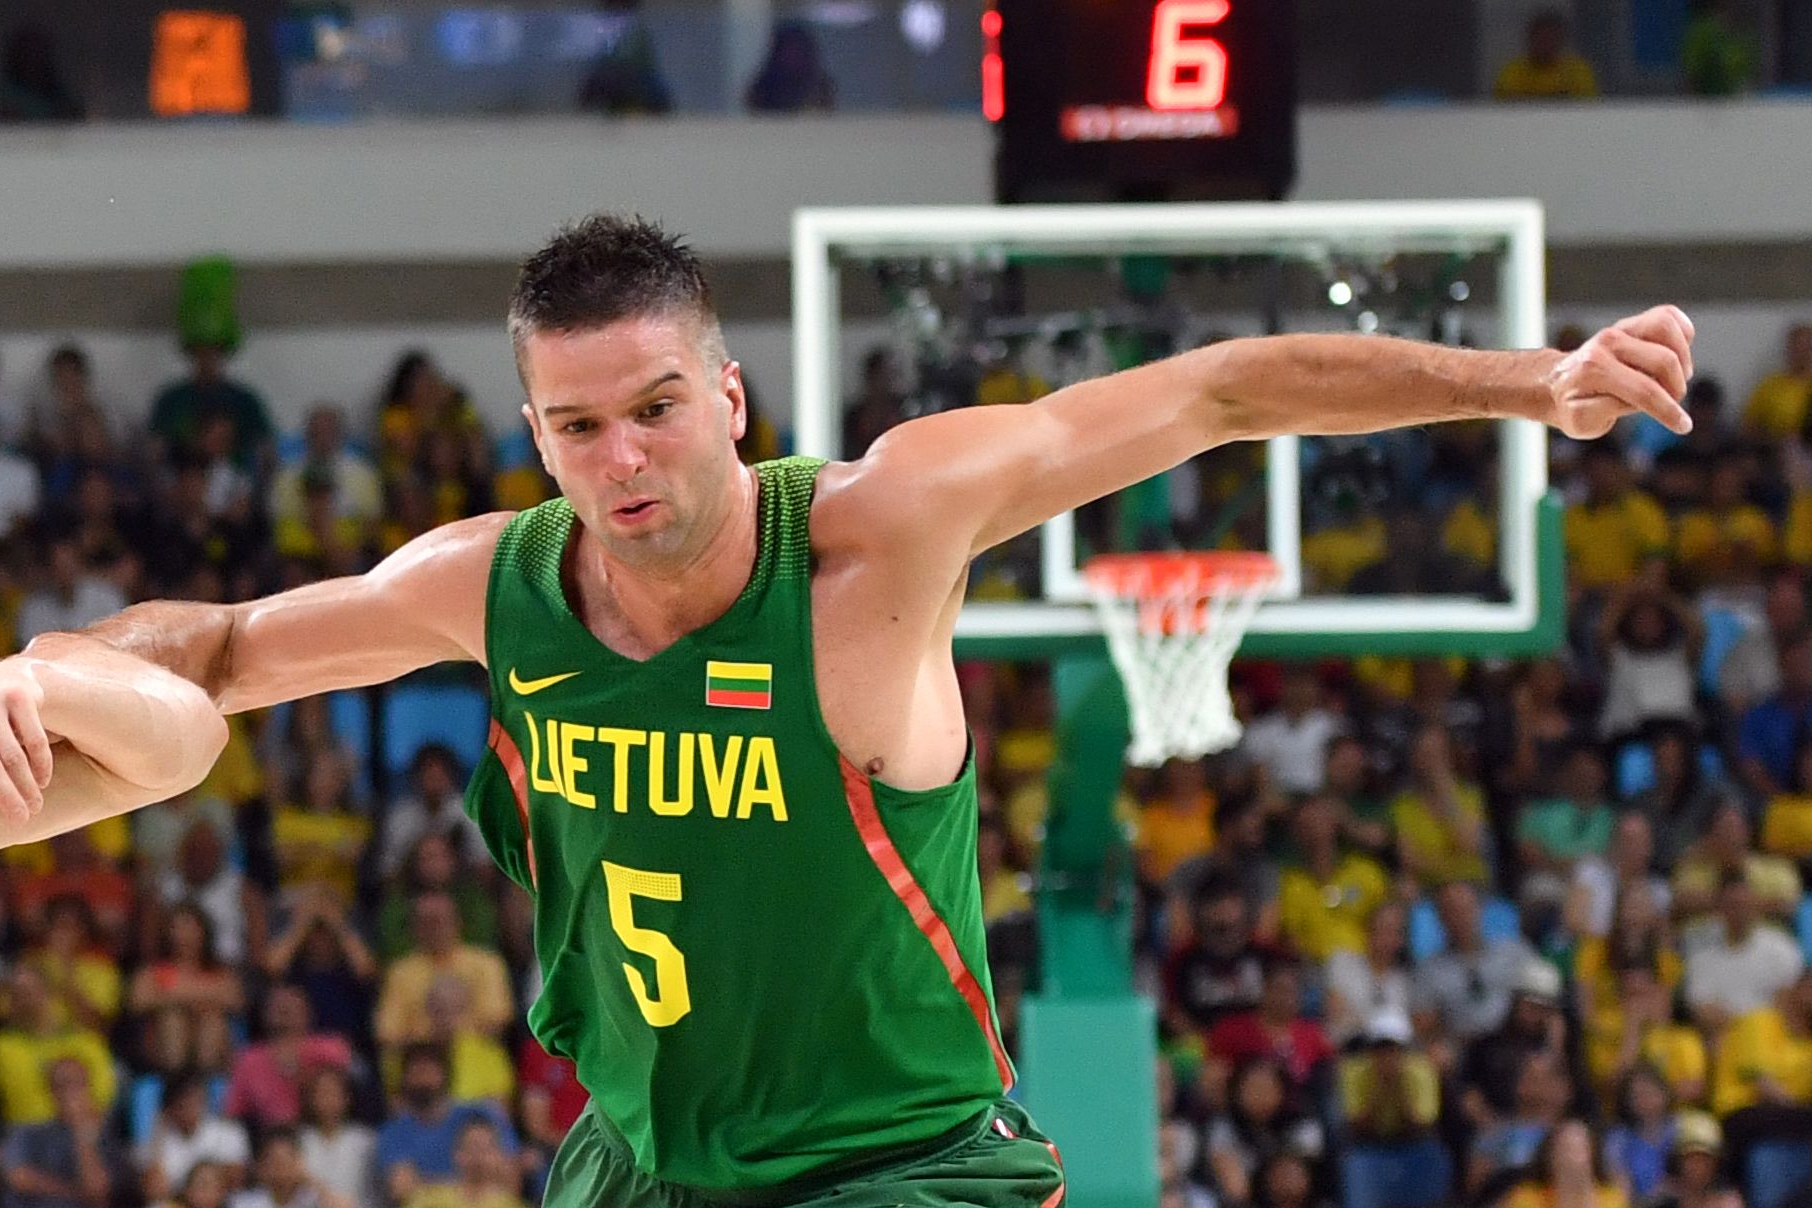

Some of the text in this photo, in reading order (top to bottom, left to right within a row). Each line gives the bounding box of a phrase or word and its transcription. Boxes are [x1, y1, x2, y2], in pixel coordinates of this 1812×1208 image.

[1146, 0, 1231, 112] 6
[524, 710, 788, 822] LIETUVA
[601, 860, 692, 1027] 5
